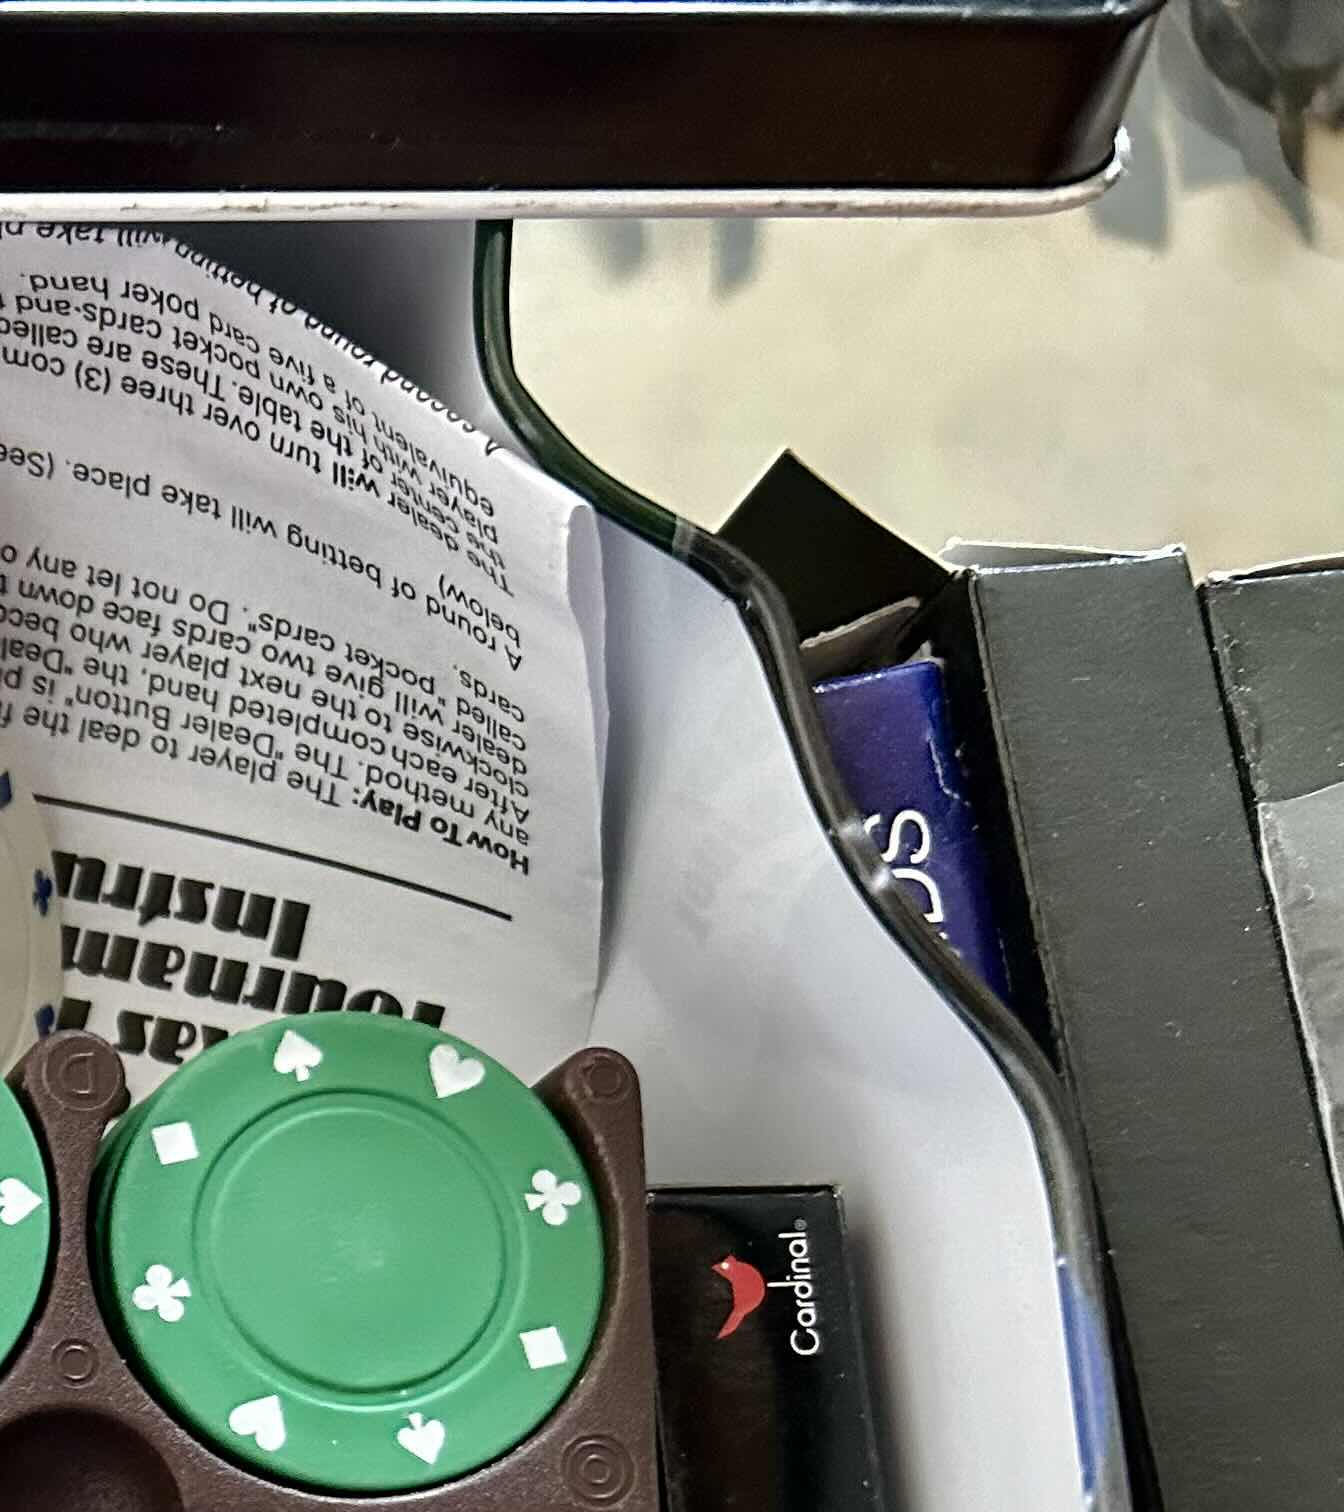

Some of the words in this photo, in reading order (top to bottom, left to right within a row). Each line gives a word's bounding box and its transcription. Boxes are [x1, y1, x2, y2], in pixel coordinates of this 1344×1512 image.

[19, 272, 109, 300] hand.
[120, 280, 199, 322] poker
[87, 336, 131, 363] are
[208, 312, 261, 355] card
[172, 327, 261, 381] pocket
[269, 346, 314, 384] five
[74, 360, 111, 395] (3)
[142, 350, 225, 401] These
[270, 372, 323, 411] own
[323, 374, 335, 394] a
[121, 374, 194, 416] three
[232, 382, 301, 433] table.
[343, 391, 365, 414] of
[202, 402, 260, 443] over
[311, 421, 352, 455] the
[332, 406, 366, 443] his
[269, 433, 322, 474] turn
[362, 448, 383, 474] of
[371, 411, 495, 518] equivalent
[374, 435, 421, 486] with
[65, 459, 151, 499] place.
[332, 461, 380, 498] will
[161, 484, 222, 521] take
[391, 472, 458, 534] center
[430, 483, 497, 544] player
[231, 505, 277, 539] will
[387, 492, 459, 552] dealer
[26, 545, 77, 579] any
[286, 524, 382, 589] betting
[466, 532, 504, 569] the
[87, 564, 122, 597] let
[131, 575, 179, 606] not
[390, 576, 417, 601] of
[466, 550, 514, 598] The
[18, 580, 94, 617] down
[188, 593, 229, 625] Do
[438, 574, 521, 648] below)
[102, 601, 162, 636] face
[171, 618, 251, 656] cards
[241, 606, 336, 651] cards".
[426, 594, 497, 652] round
[70, 623, 131, 654] who
[83, 657, 128, 686] the
[141, 642, 229, 681] player
[262, 644, 315, 675] two
[344, 642, 446, 706] "pocket
[504, 645, 522, 671] A
[32, 675, 55, 702] is
[141, 668, 218, 711] hand,
[238, 666, 301, 699] next
[325, 664, 384, 699] give
[452, 664, 525, 724] cards.
[23, 706, 70, 736] the
[65, 685, 170, 730] Button"
[311, 688, 357, 722] the
[365, 707, 391, 734] to
[395, 691, 444, 727] will
[456, 697, 526, 751] called
[78, 719, 141, 751] deal
[181, 713, 284, 760] "Dealer
[229, 695, 385, 756] completed
[152, 736, 178, 760] to
[189, 746, 277, 787] player
[295, 743, 348, 781] The
[392, 745, 457, 785] each
[403, 722, 529, 799] clockwise
[452, 720, 527, 777] dealer
[287, 770, 341, 807] The
[358, 761, 474, 819] method.
[465, 777, 529, 825] After
[352, 788, 422, 833] Play:
[485, 811, 529, 847] any
[430, 817, 462, 847] To
[466, 831, 529, 875] How
